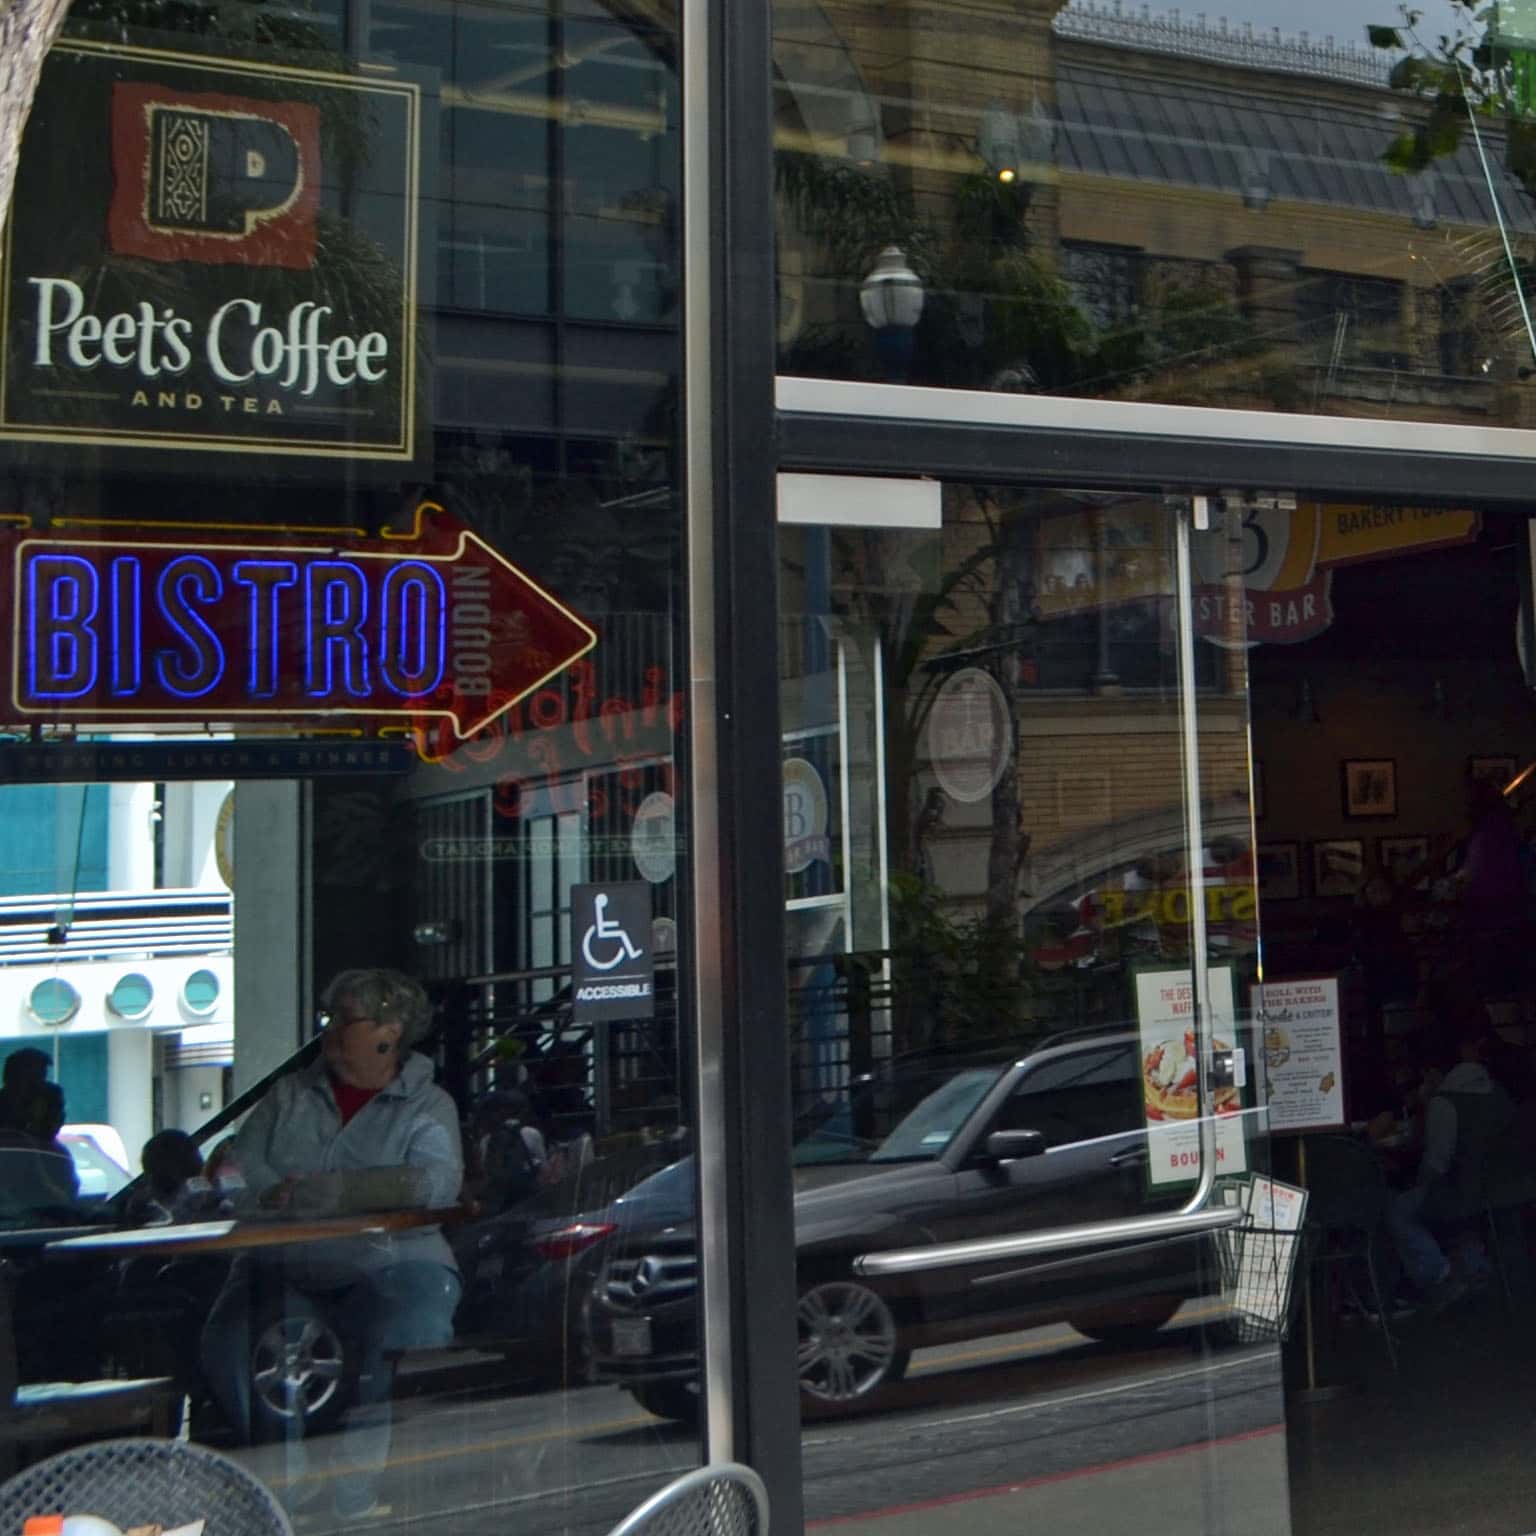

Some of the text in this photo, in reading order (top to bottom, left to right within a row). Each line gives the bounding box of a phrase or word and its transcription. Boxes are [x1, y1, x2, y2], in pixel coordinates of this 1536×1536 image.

[207, 299, 388, 395] Coffee
[132, 390, 283, 415] AND TEA
[29, 554, 447, 698] BISTRO
[1269, 593, 1316, 628] BAR
[451, 565, 491, 697] BOUDIN
[576, 983, 651, 1000] ACCESSIBLE
[1170, 1149, 1225, 1168] BOUN
